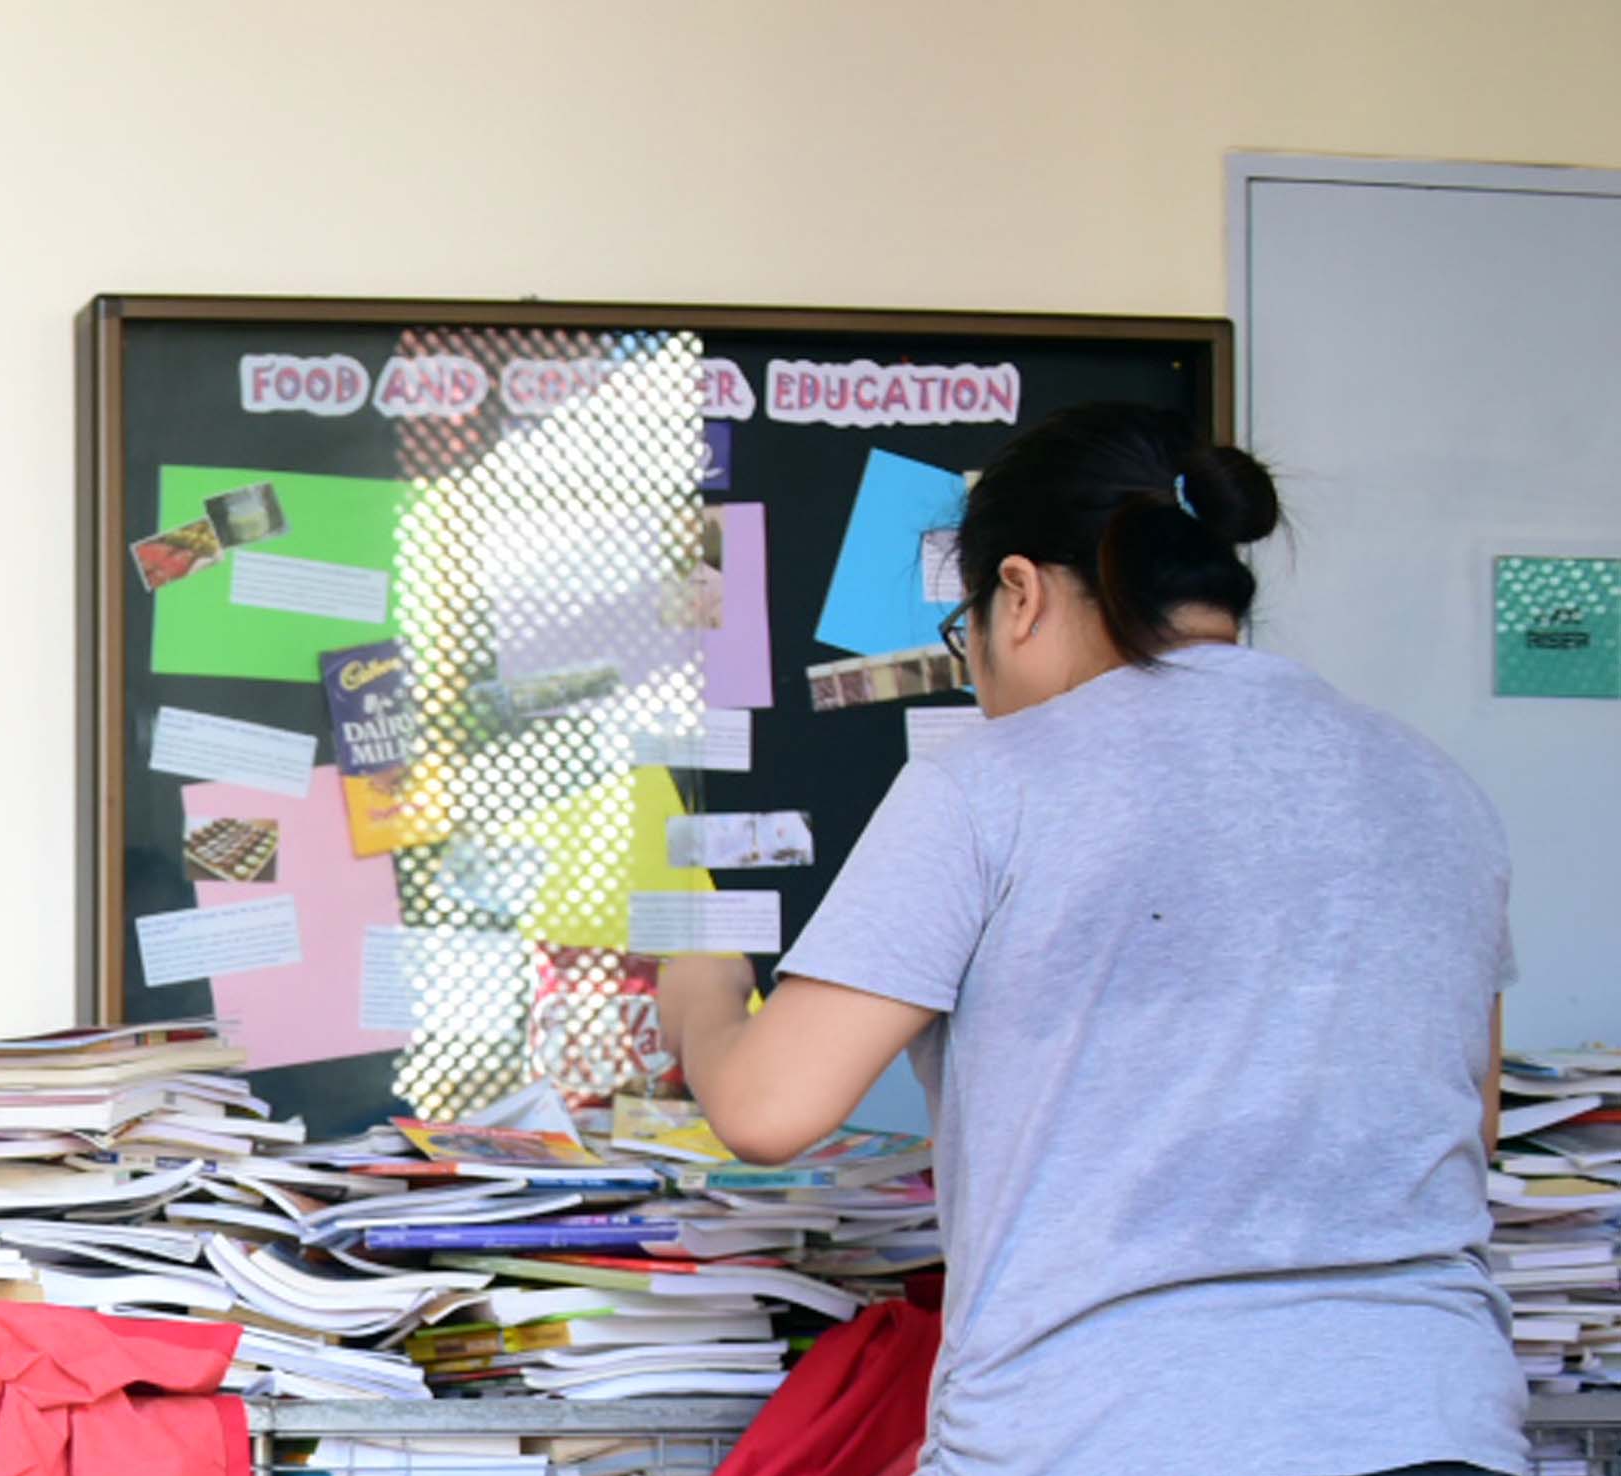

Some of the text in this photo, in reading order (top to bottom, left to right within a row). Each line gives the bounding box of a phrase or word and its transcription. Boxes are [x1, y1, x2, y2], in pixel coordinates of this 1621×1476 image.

[252, 366, 362, 402] FOOD
[380, 367, 480, 404] AND
[774, 371, 1014, 414] EDUCATION
[343, 711, 420, 744] DAIR
